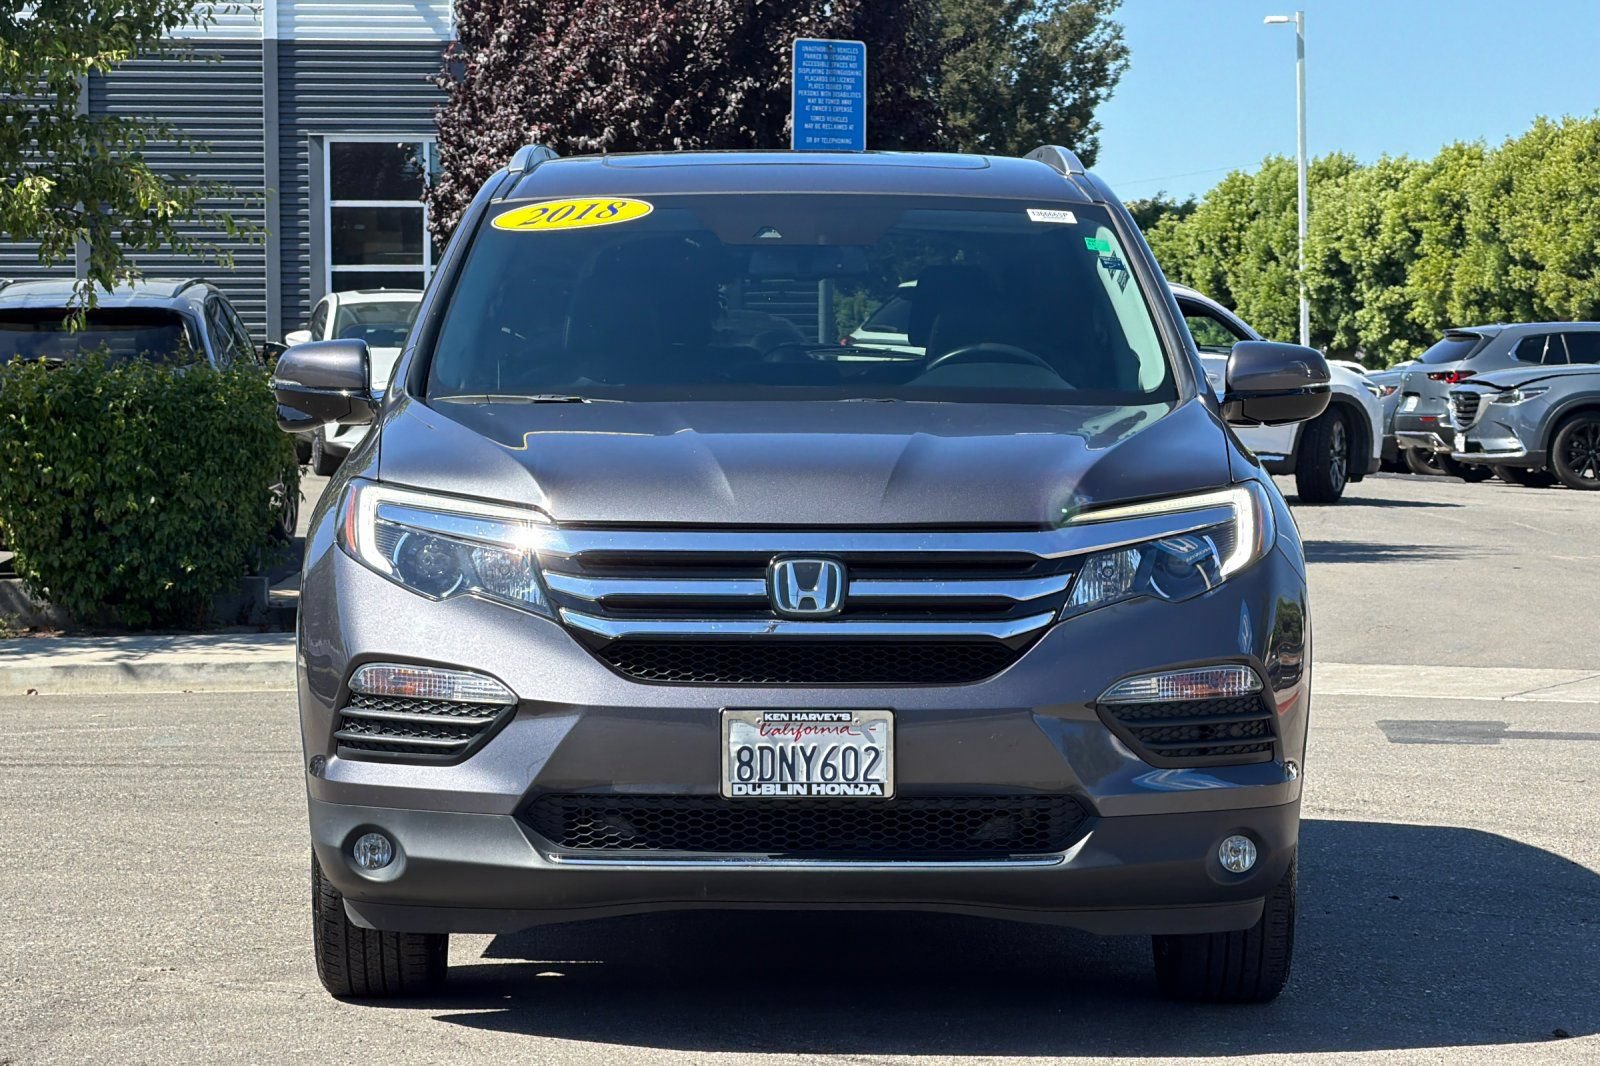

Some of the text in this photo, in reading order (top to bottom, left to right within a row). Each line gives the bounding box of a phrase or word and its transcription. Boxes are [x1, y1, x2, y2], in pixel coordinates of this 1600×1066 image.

[517, 201, 627, 226] 2018
[764, 713, 851, 721] KEN HARVEY'S
[759, 722, 861, 742] California
[736, 745, 880, 782] 8DNY602
[732, 783, 883, 795] DUBLIN HONDA
